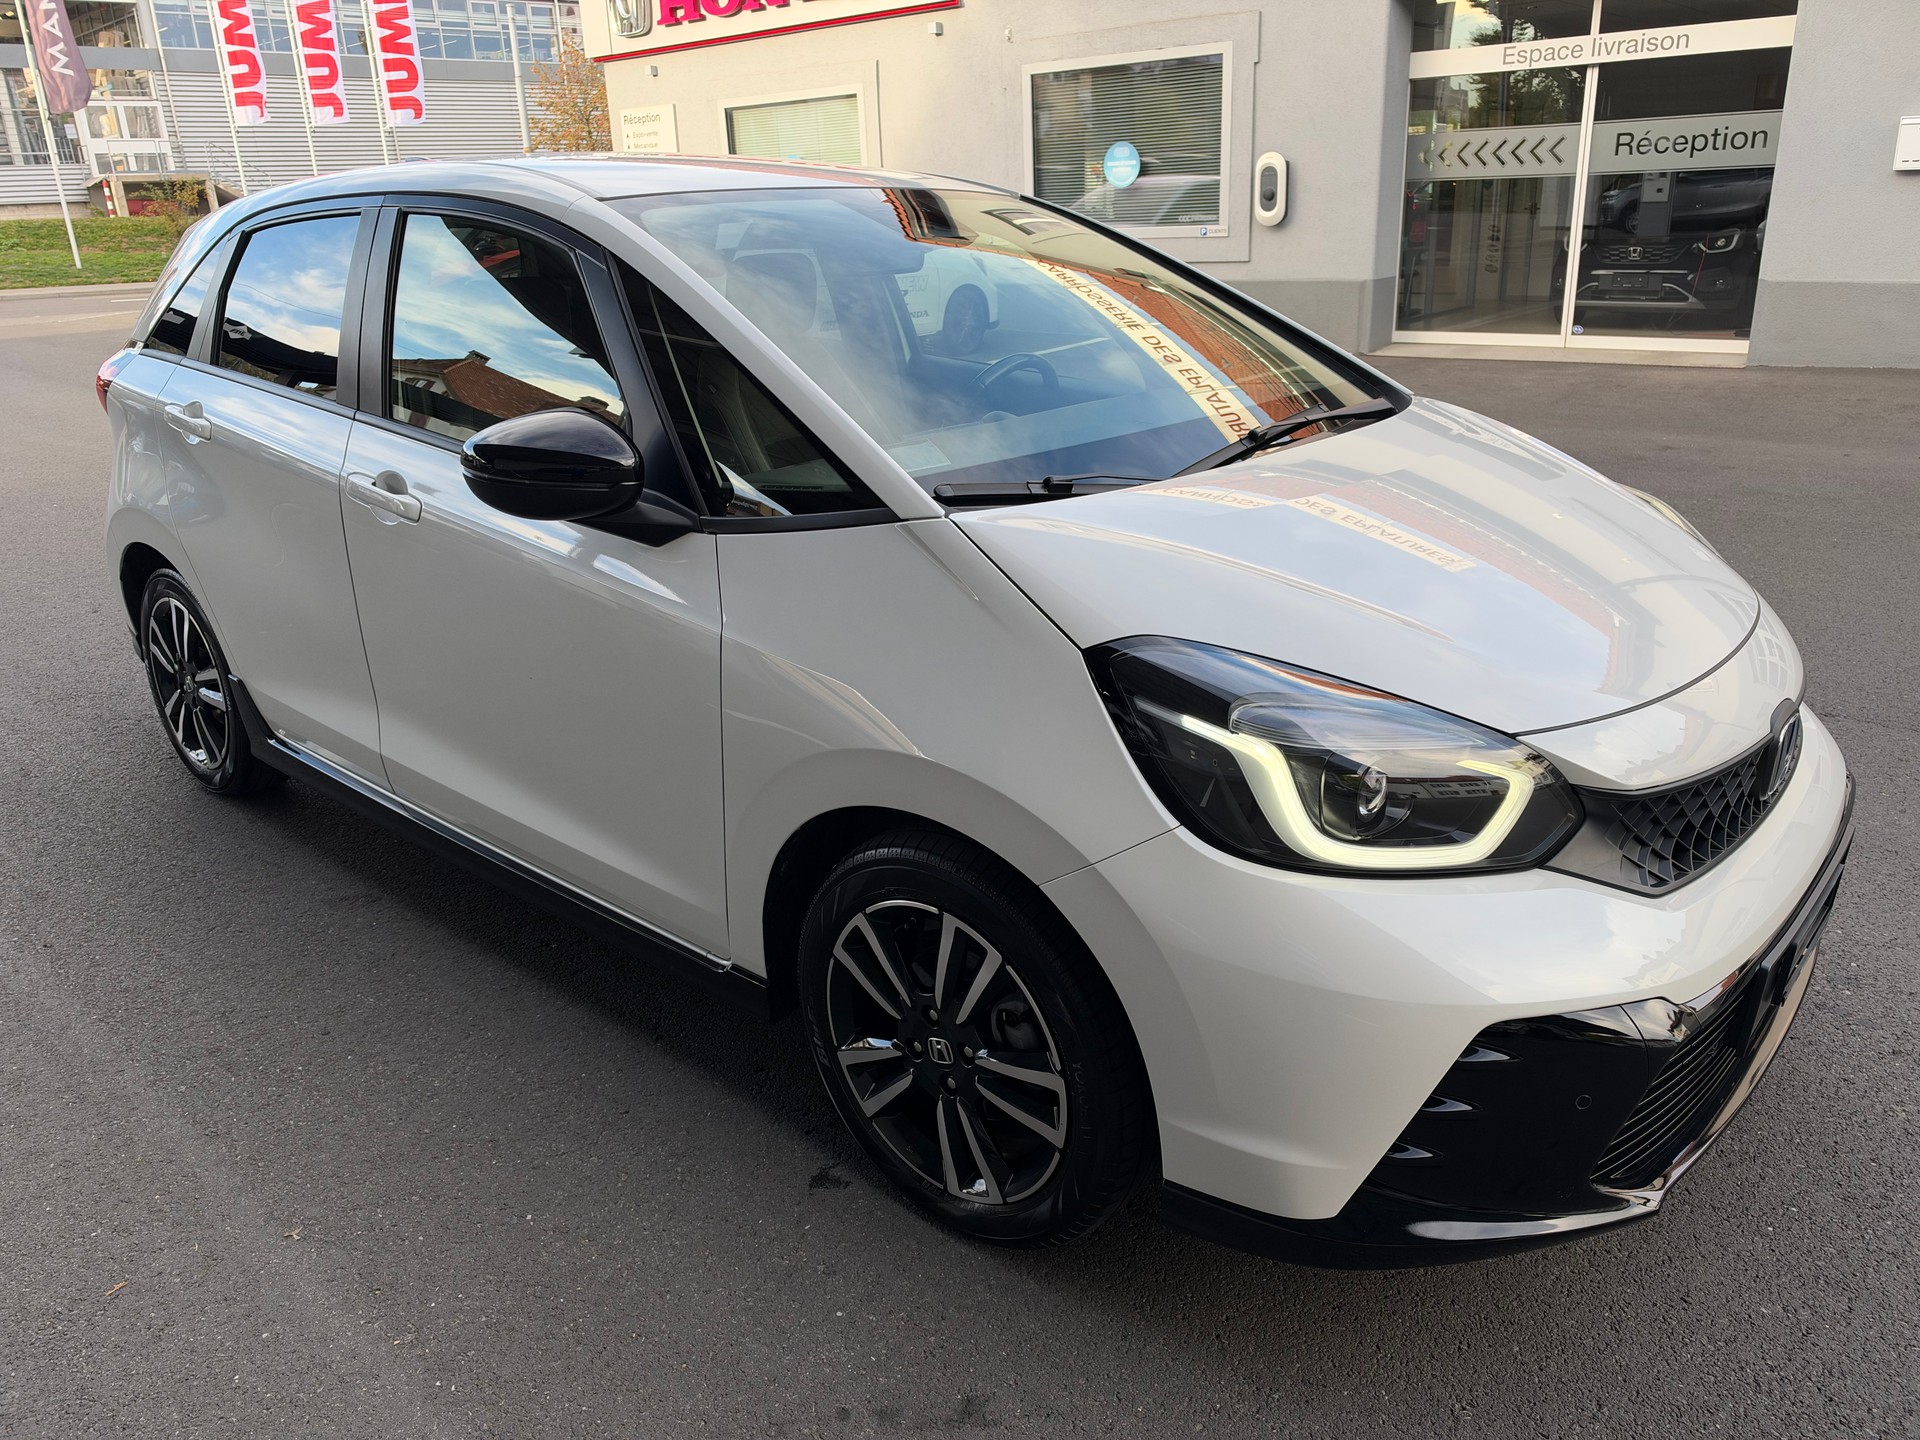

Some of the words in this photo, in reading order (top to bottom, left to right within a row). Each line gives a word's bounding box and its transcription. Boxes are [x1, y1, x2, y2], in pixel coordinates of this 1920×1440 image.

[1502, 45, 1583, 67] Espace
[1591, 33, 1690, 57] livraison
[623, 112, 660, 125] Réception
[1614, 126, 1769, 158] Réception
